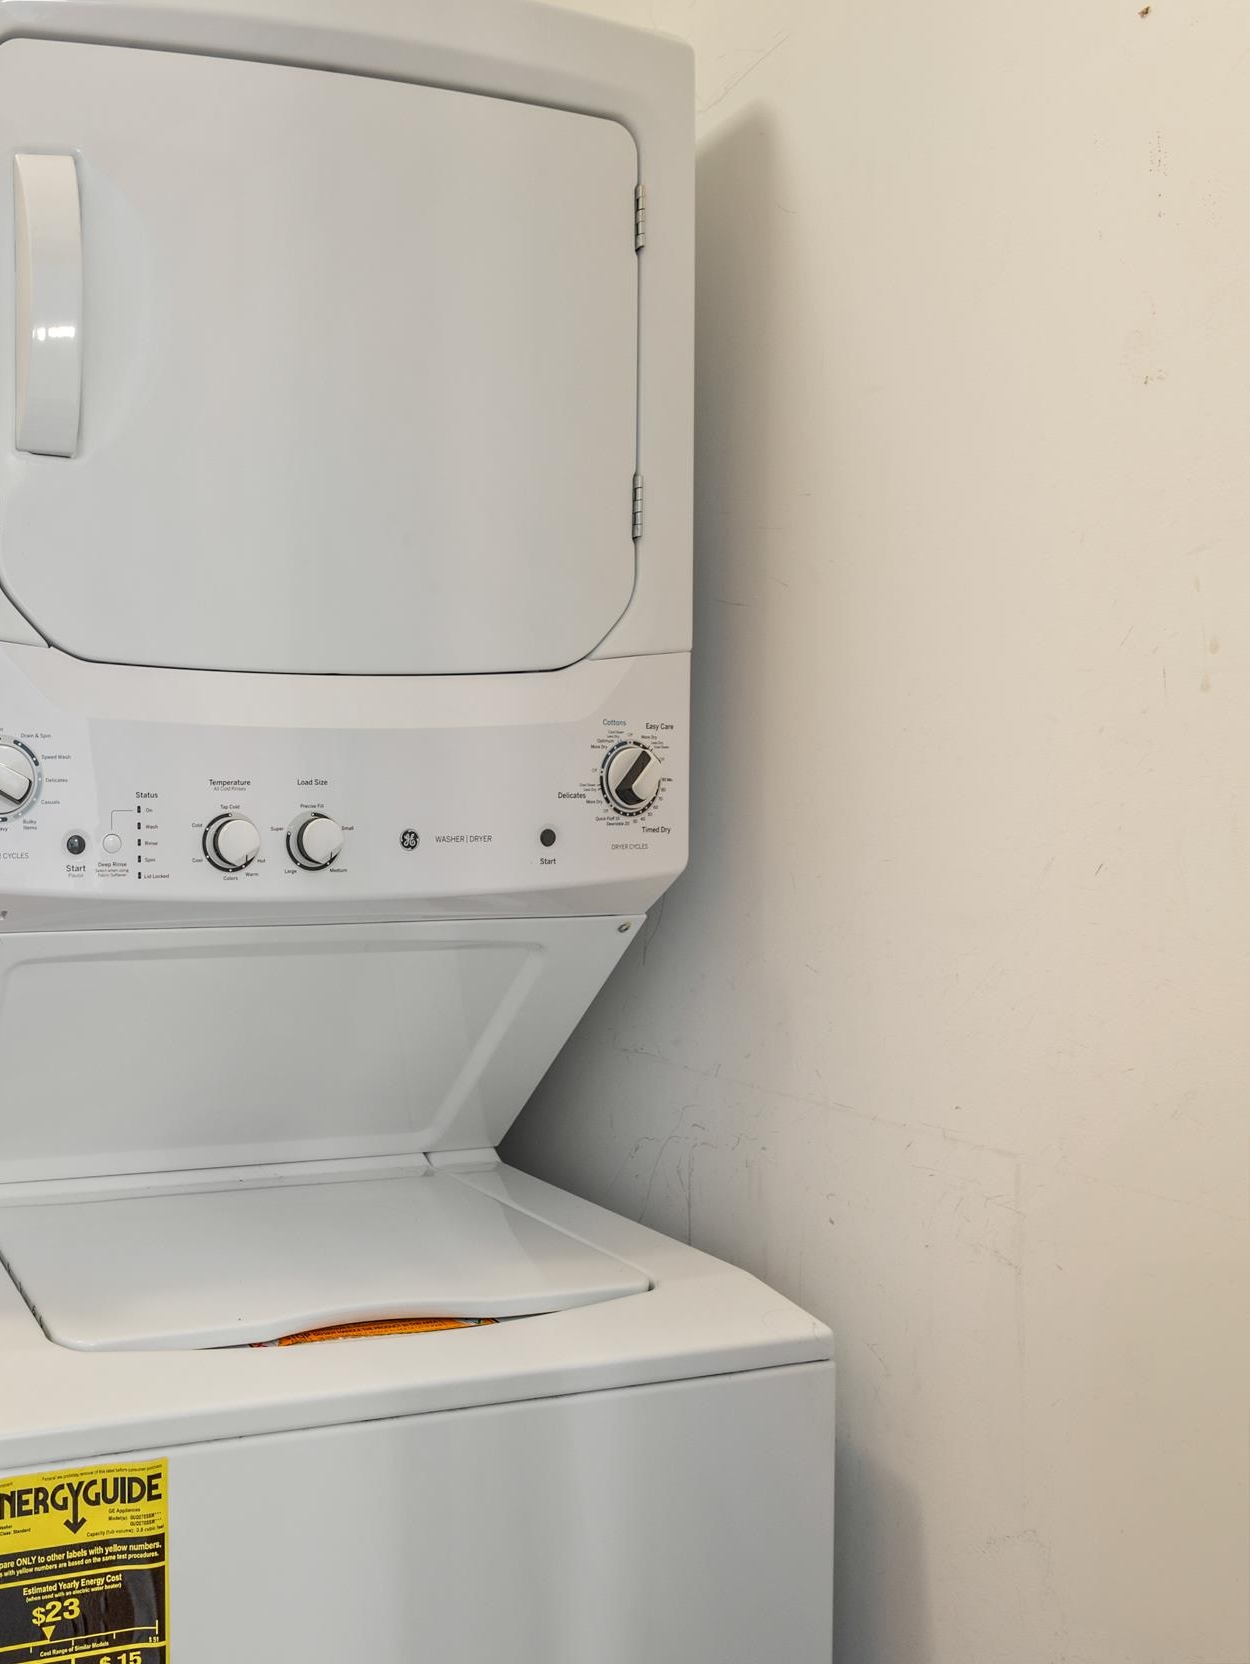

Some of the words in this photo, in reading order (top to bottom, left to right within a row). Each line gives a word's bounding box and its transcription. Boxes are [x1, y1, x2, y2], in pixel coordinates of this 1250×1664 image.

[645, 722, 659, 731] Easy
[209, 779, 251, 787] Temperature
[135, 791, 158, 799] Status
[557, 791, 586, 799] Delicates
[660, 826, 671, 834] Dry
[469, 835, 493, 843] DRYER
[539, 857, 556, 865] Start
[66, 864, 86, 872] Start
[15, 1556, 37, 1567] ONLY
[37, 1555, 45, 1563] to
[46, 1552, 65, 1562] other
[66, 1548, 88, 1559] labels
[88, 1546, 104, 1555] with
[104, 1543, 128, 1555] yellow
[128, 1541, 162, 1551] numbers.
[3, 1569, 15, 1577] with
[16, 1566, 34, 1577] yellow
[34, 1564, 58, 1573] numbers
[68, 1558, 84, 1567] based
[22, 1582, 58, 1596] Estimated
[58, 1579, 80, 1590] Yearly
[80, 1576, 105, 1587] Energy
[106, 1573, 123, 1583] Cost
[72, 1587, 90, 1595] electric
[31, 1597, 81, 1627] $23
